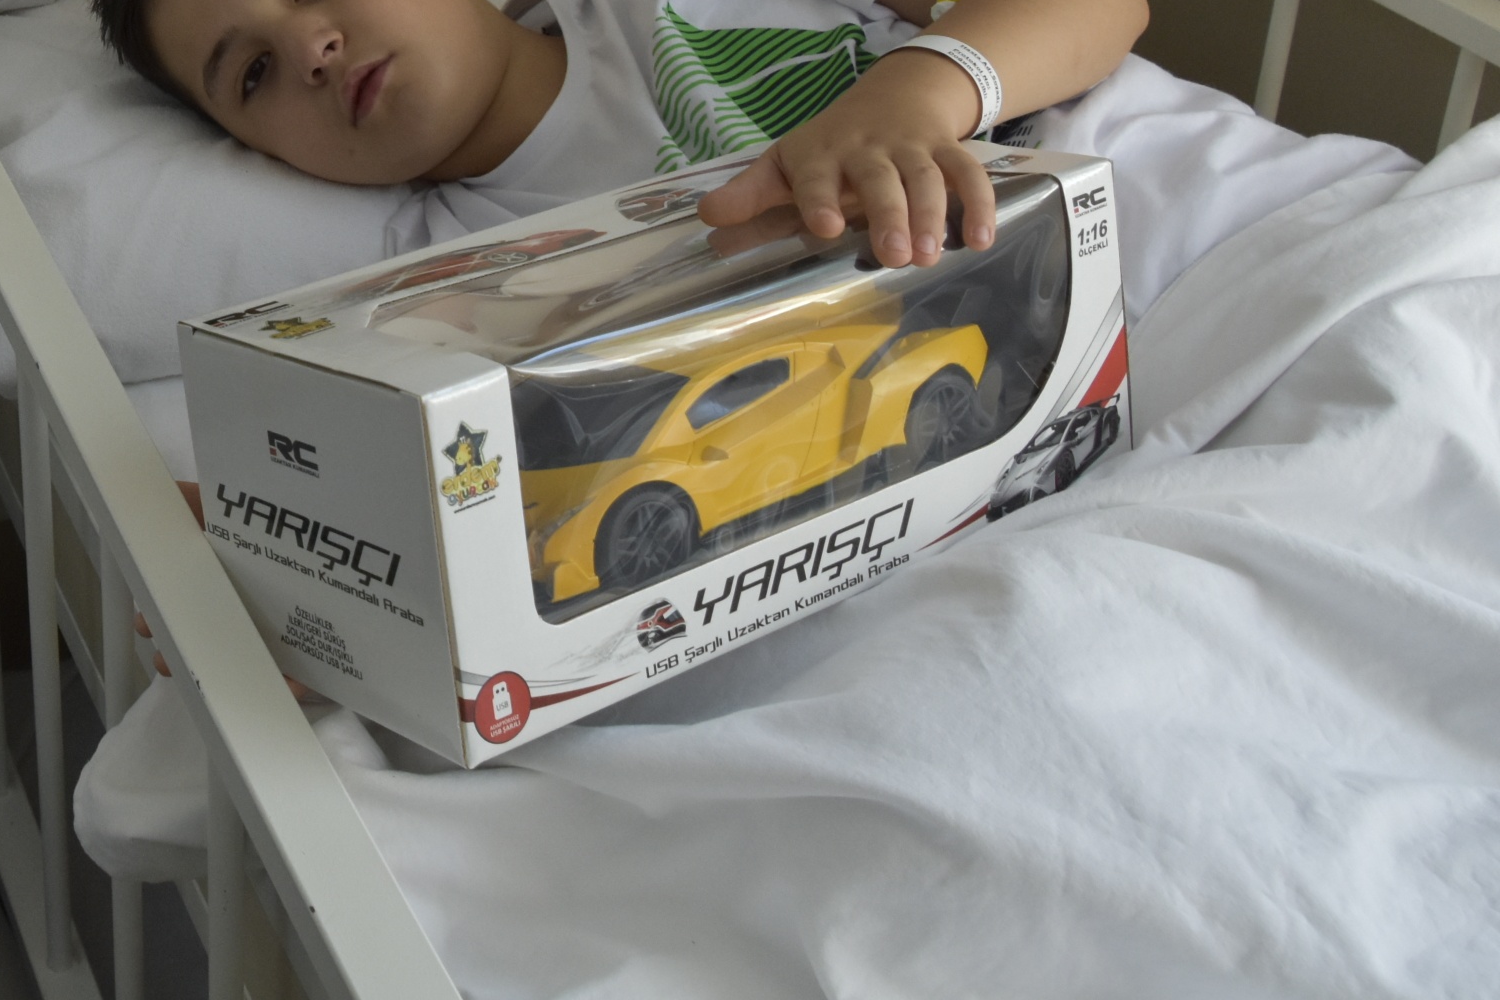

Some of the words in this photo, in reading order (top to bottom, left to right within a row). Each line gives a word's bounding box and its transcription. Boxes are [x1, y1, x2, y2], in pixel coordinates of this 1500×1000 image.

[1072, 186, 1107, 210] RC
[1077, 219, 1108, 246] 1:16
[1078, 238, 1109, 258] ÖLÇEKLİ
[266, 430, 319, 471] RC
[216, 483, 402, 587] YARIŞÇI
[207, 521, 231, 541] USB
[232, 533, 262, 557] Şarjlı
[264, 546, 315, 579] Uzaktan
[318, 569, 380, 607] Kumandalı
[382, 597, 425, 627] Araba
[693, 497, 915, 626] YARIŞÇI
[645, 654, 680, 679] USB
[684, 636, 724, 664] Şarjlı
[727, 606, 791, 643] Uzaktan
[794, 572, 865, 612] Kumandalı
[867, 552, 911, 580] Araba
[325, 655, 340, 670] USB
[495, 700, 509, 713] USB
[490, 726, 503, 738] USB
